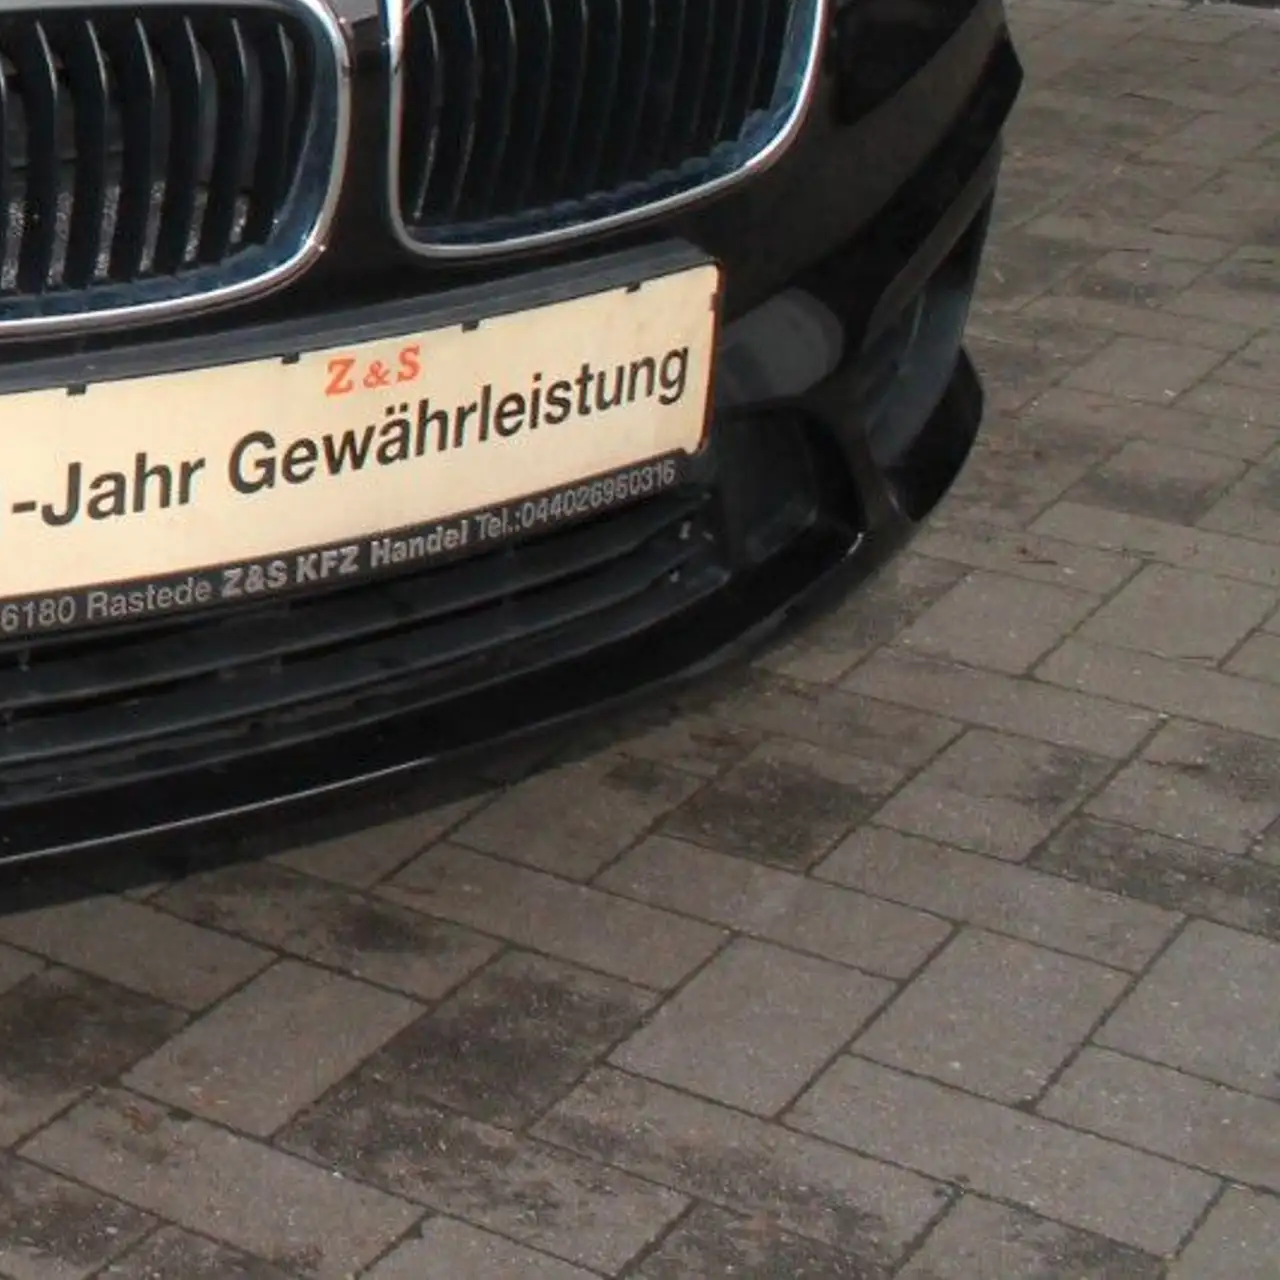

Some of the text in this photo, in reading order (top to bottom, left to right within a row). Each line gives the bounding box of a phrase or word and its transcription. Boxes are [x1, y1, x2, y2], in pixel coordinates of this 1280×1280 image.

[228, 345, 690, 495] Gewährleistung
[86, 575, 213, 621] Rastede
[220, 559, 289, 600] Z&S
[295, 545, 362, 585] KFZ
[369, 518, 470, 569] Handel
